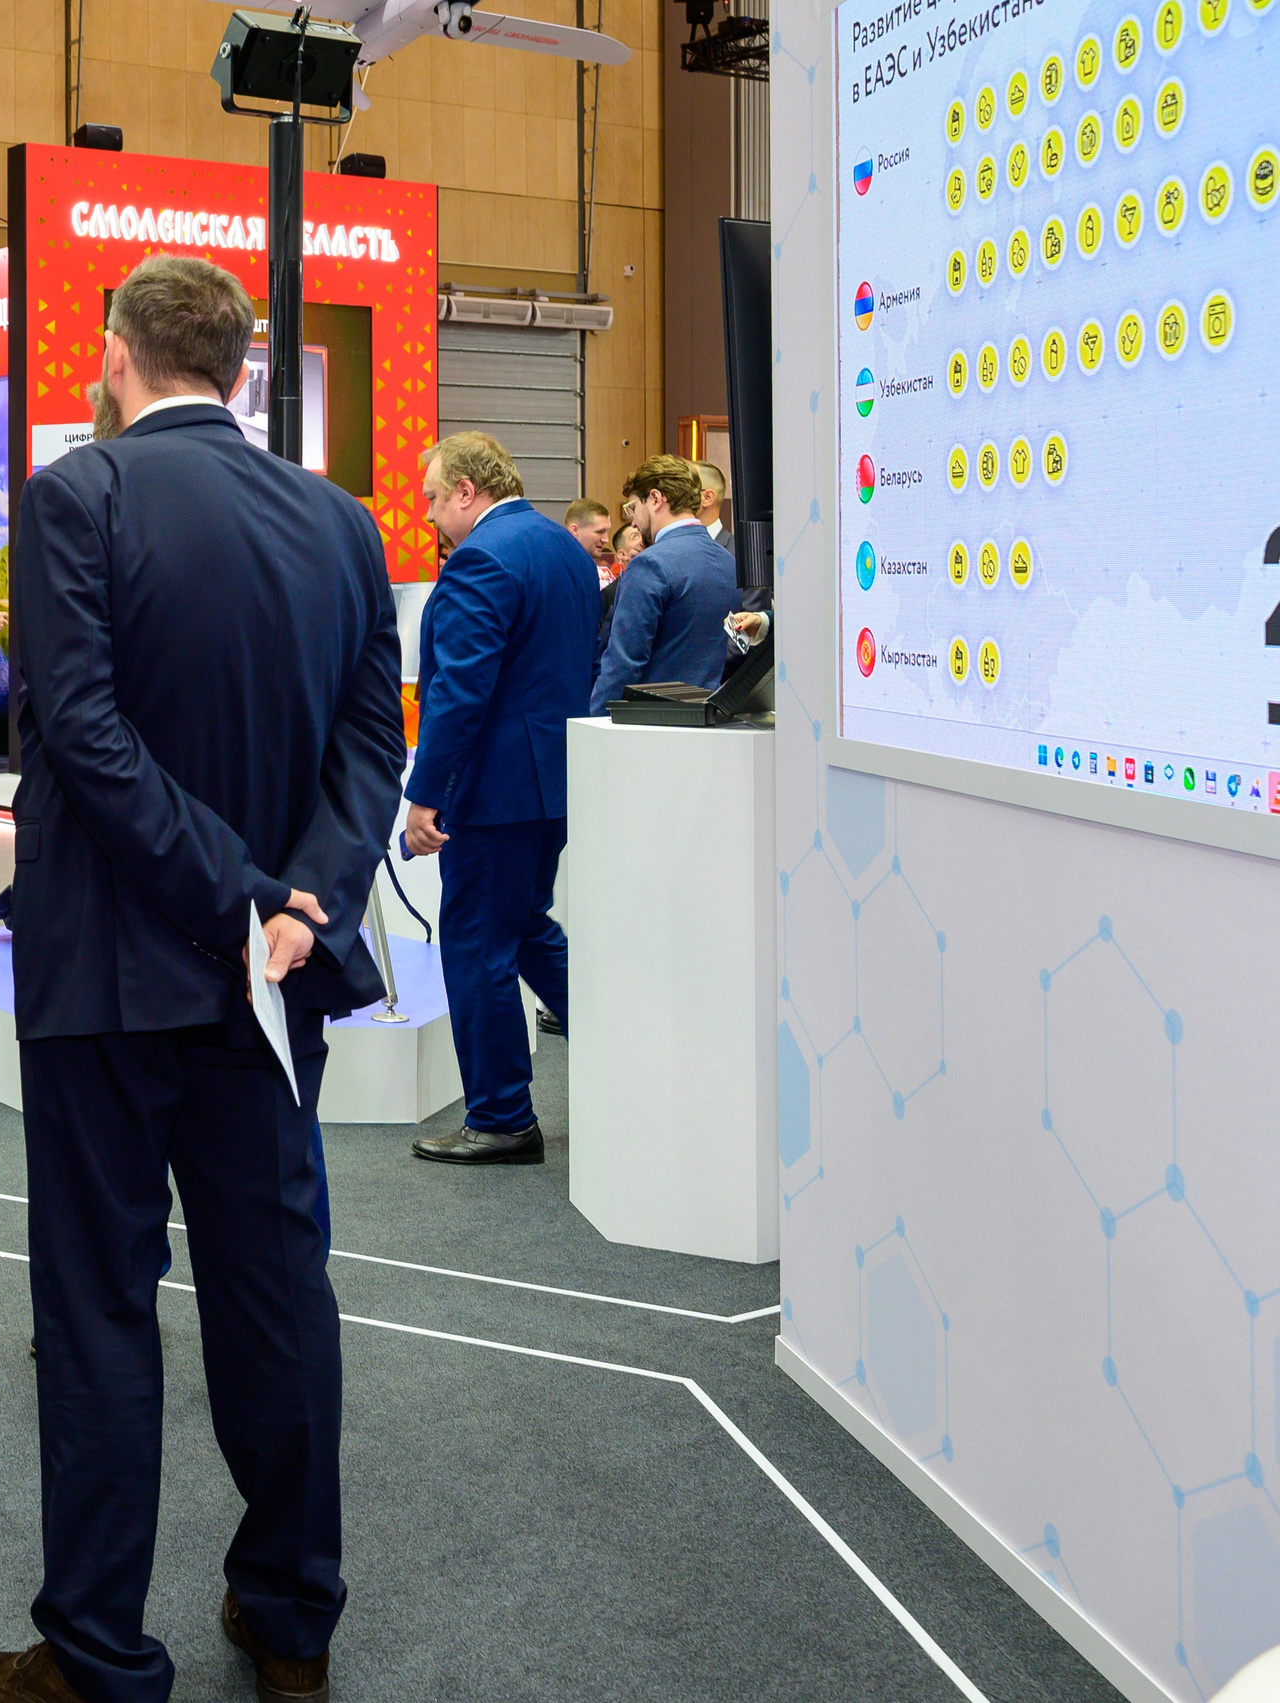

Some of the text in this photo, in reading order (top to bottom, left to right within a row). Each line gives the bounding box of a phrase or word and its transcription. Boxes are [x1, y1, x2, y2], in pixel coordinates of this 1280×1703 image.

[852, 0, 922, 53] Развитие
[852, 82, 860, 104] в
[864, 44, 908, 97] ЕАЭС
[912, 46, 922, 71] и
[877, 147, 910, 173] Россия
[71, 200, 400, 262] СМОЛЕНСКАЯ БЛАСТЬ
[878, 286, 921, 313] Армения
[879, 375, 934, 398] Узбекистан
[64, 433, 93, 443] ЦИФР
[880, 467, 923, 489] Беларусь
[880, 556, 928, 575] Казахстан
[881, 644, 938, 670] Кыргызстан
